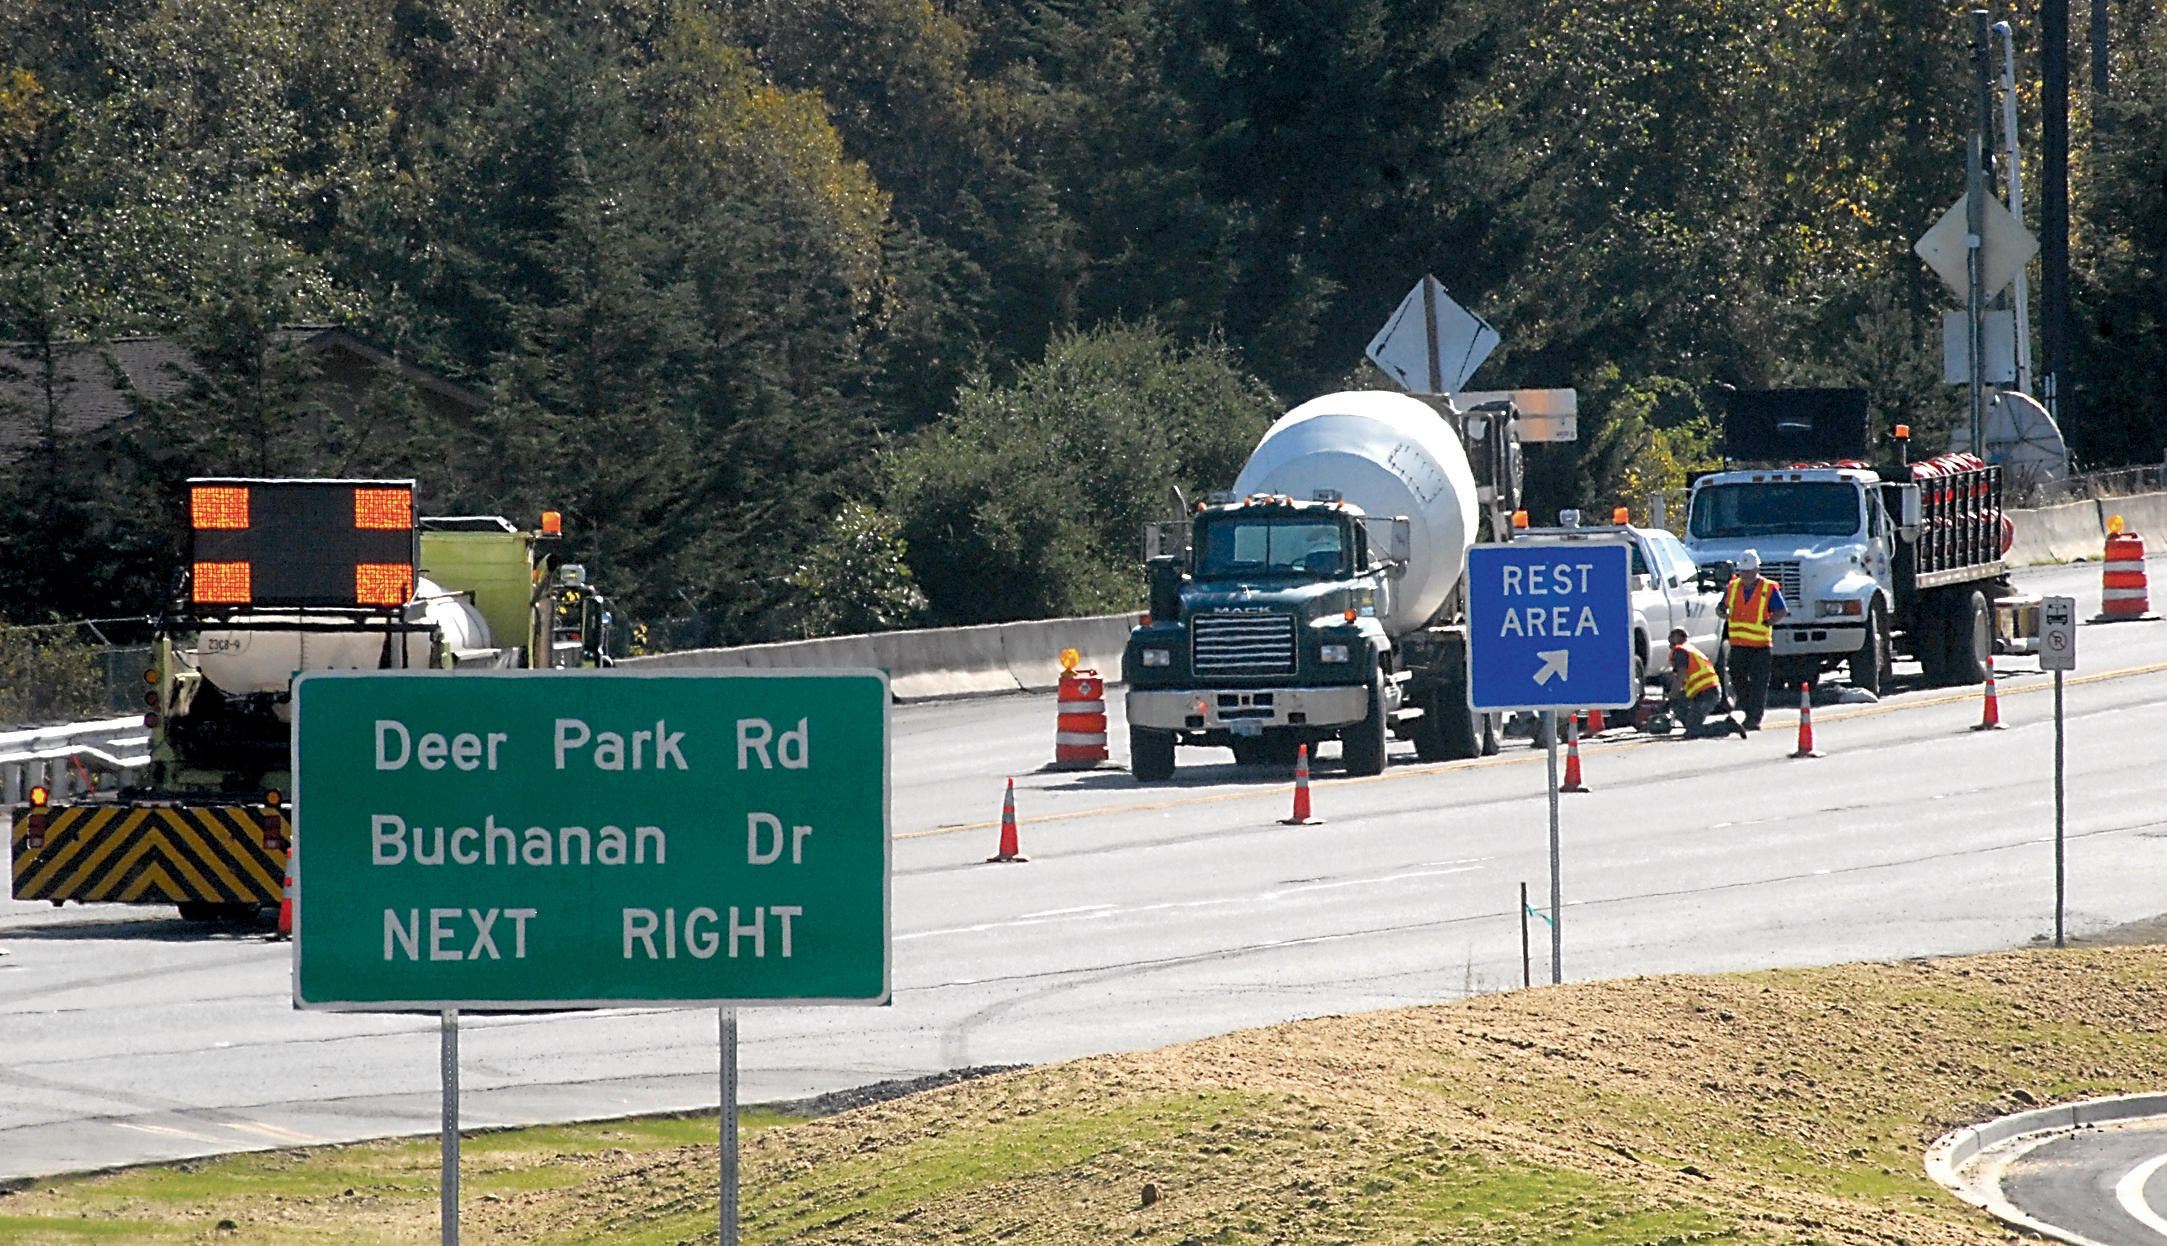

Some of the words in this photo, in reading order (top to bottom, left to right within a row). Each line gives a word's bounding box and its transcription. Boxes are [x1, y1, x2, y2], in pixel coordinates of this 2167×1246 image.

[1502, 563, 1594, 596] REST
[1214, 606, 1272, 614] MACK
[1500, 605, 1600, 638] AREA
[375, 719, 507, 771] Deer
[554, 718, 689, 770] Park
[736, 716, 809, 770] Rd
[371, 814, 666, 866] Buchanan
[747, 812, 813, 865] Dr
[383, 908, 537, 961] NEXT
[623, 906, 803, 959] RIGHT
